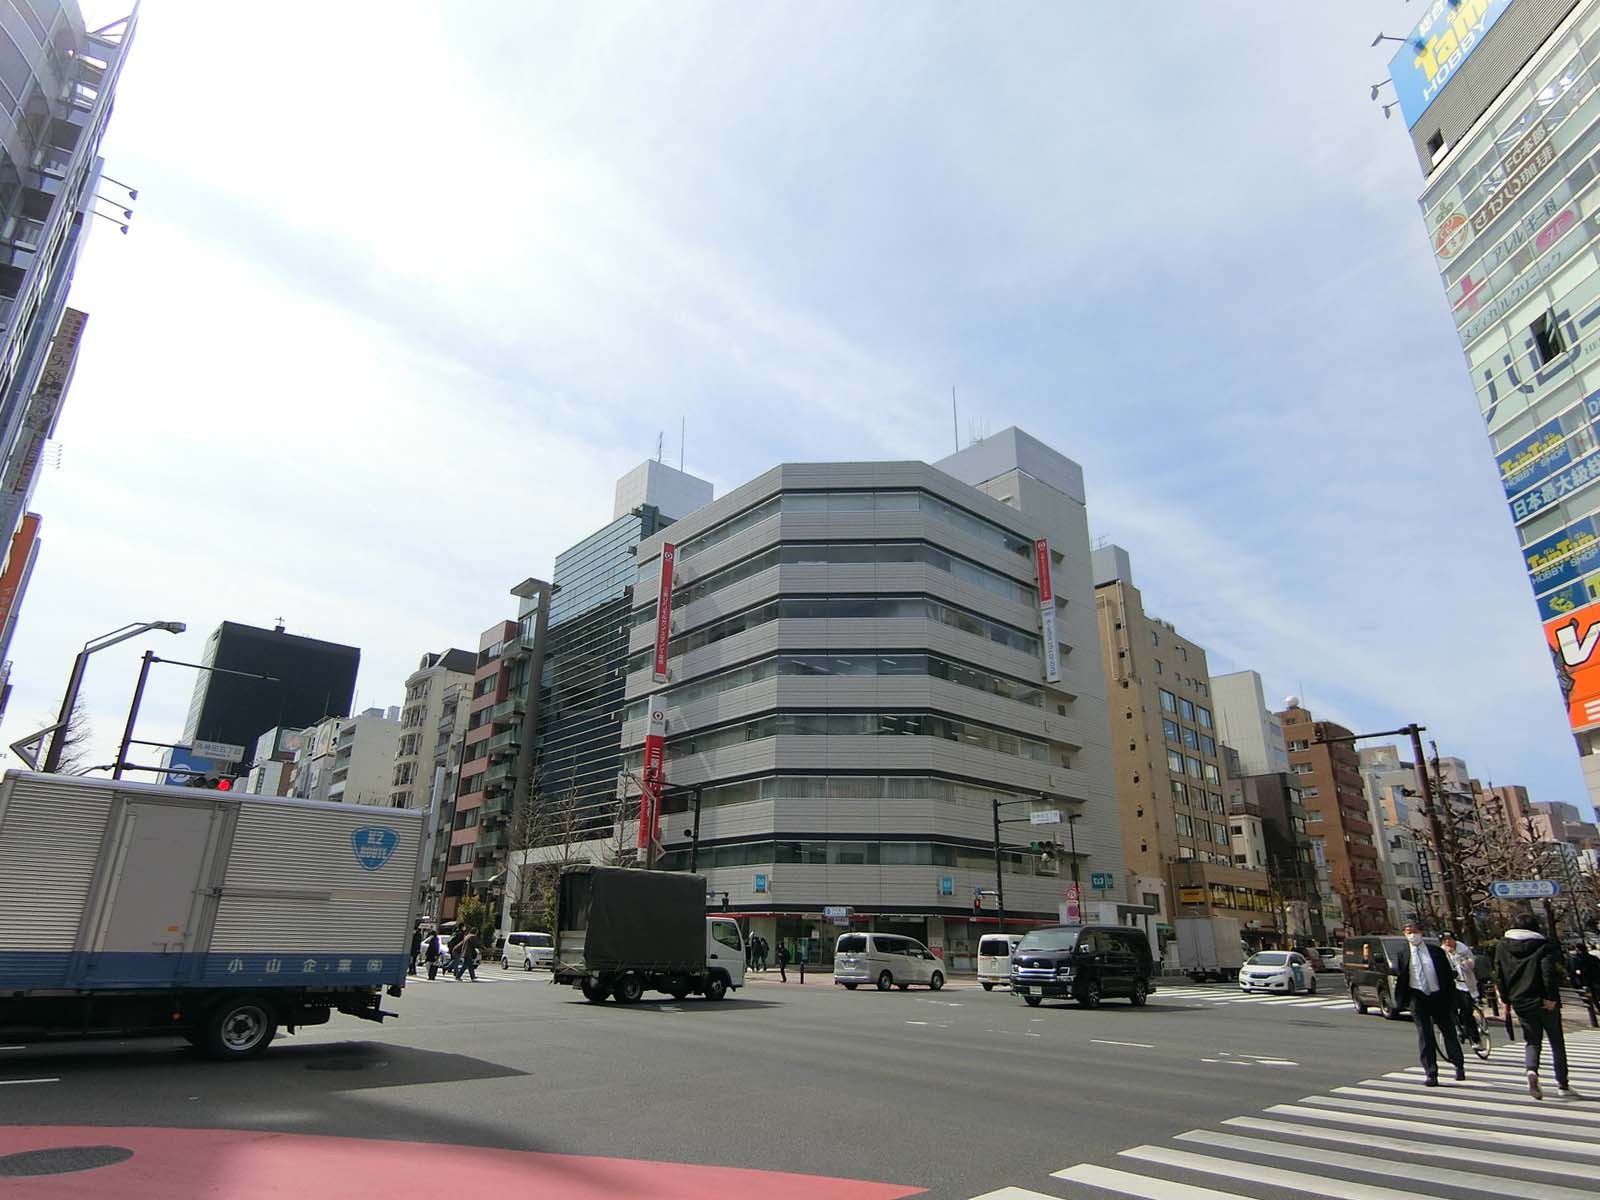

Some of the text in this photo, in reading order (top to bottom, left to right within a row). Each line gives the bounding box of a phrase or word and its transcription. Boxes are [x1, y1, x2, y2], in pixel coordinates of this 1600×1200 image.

[1423, 14, 1486, 101] HOBBY
[1504, 124, 1547, 173] FC本部
[1473, 146, 1553, 230] さかい珈琲
[1532, 563, 1565, 585] HOBBY
